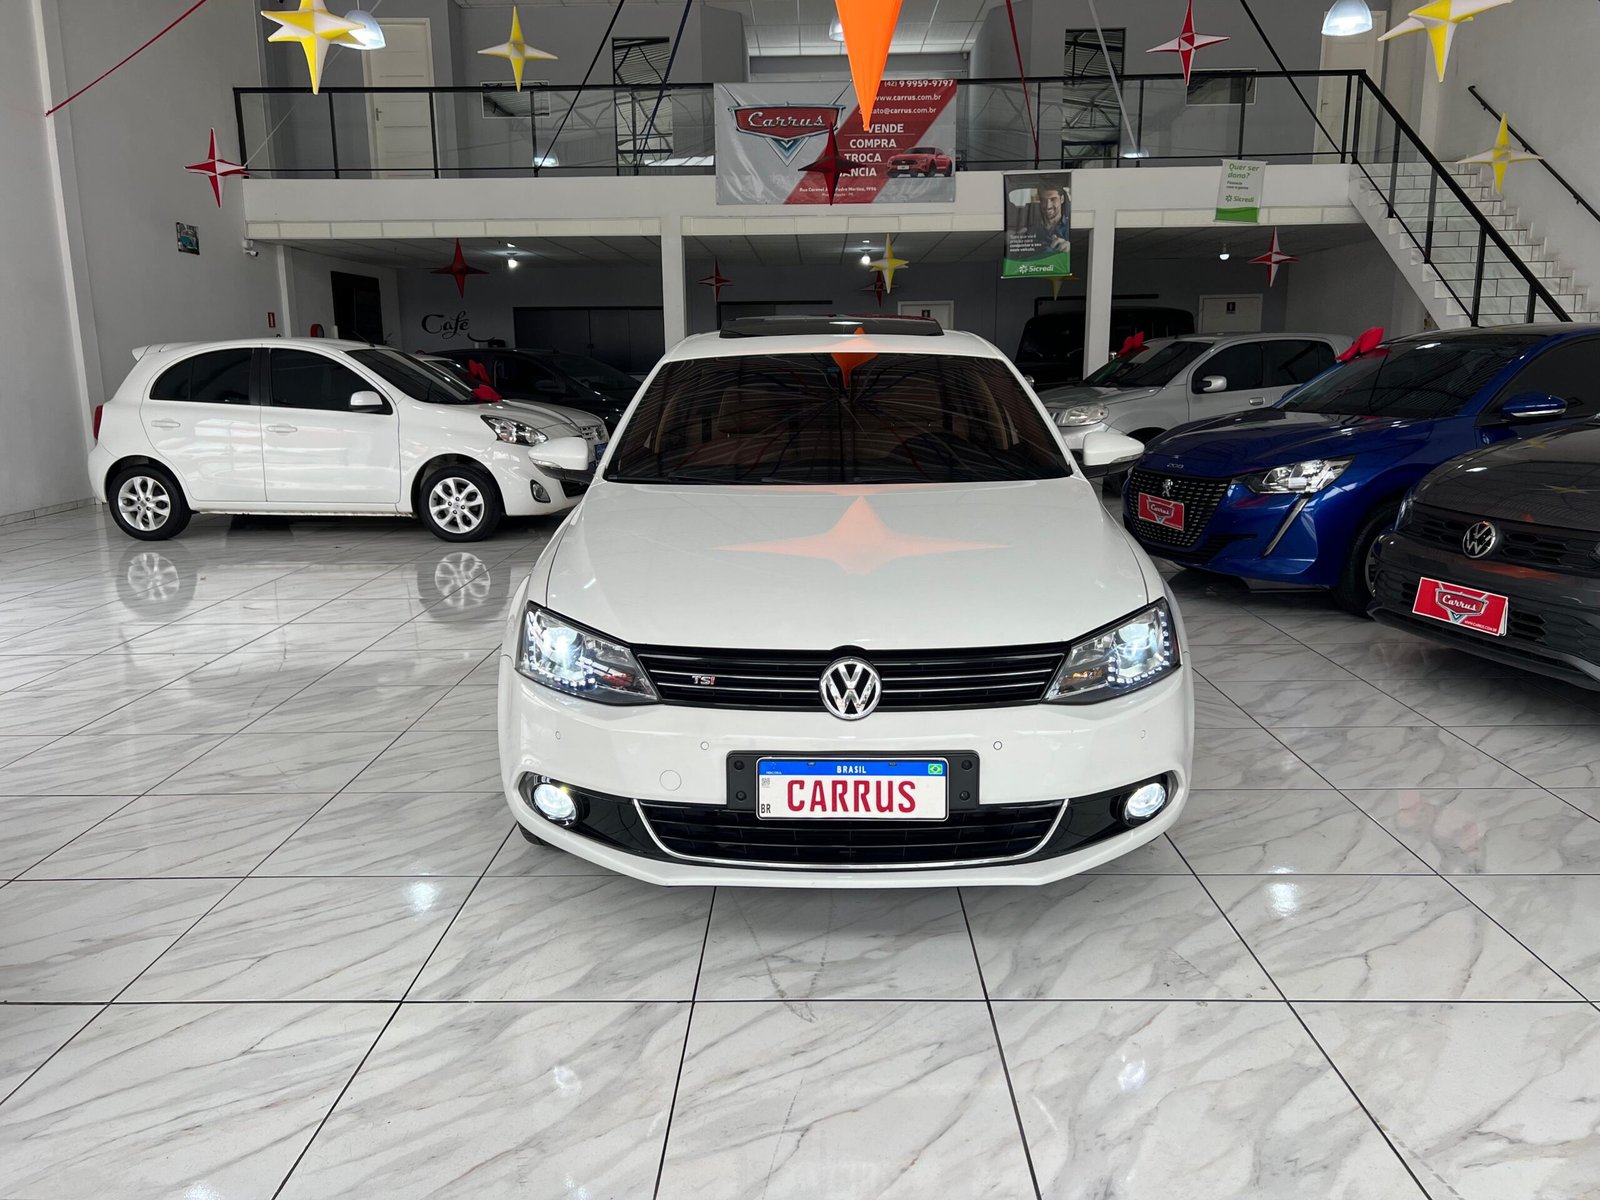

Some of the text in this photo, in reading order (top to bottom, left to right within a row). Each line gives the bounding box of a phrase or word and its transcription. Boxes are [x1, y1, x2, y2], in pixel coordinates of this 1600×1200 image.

[748, 111, 826, 127] Carrus
[868, 123, 904, 133] VENDE
[849, 138, 897, 149] COMPRA
[844, 153, 882, 163] TROCA
[1229, 163, 1247, 171] Quer
[1029, 264, 1055, 273] Sicredi
[1442, 594, 1478, 612] Carrus
[836, 765, 867, 774] BRASIL
[787, 779, 916, 813] CARRUS
[760, 803, 771, 814] BR
